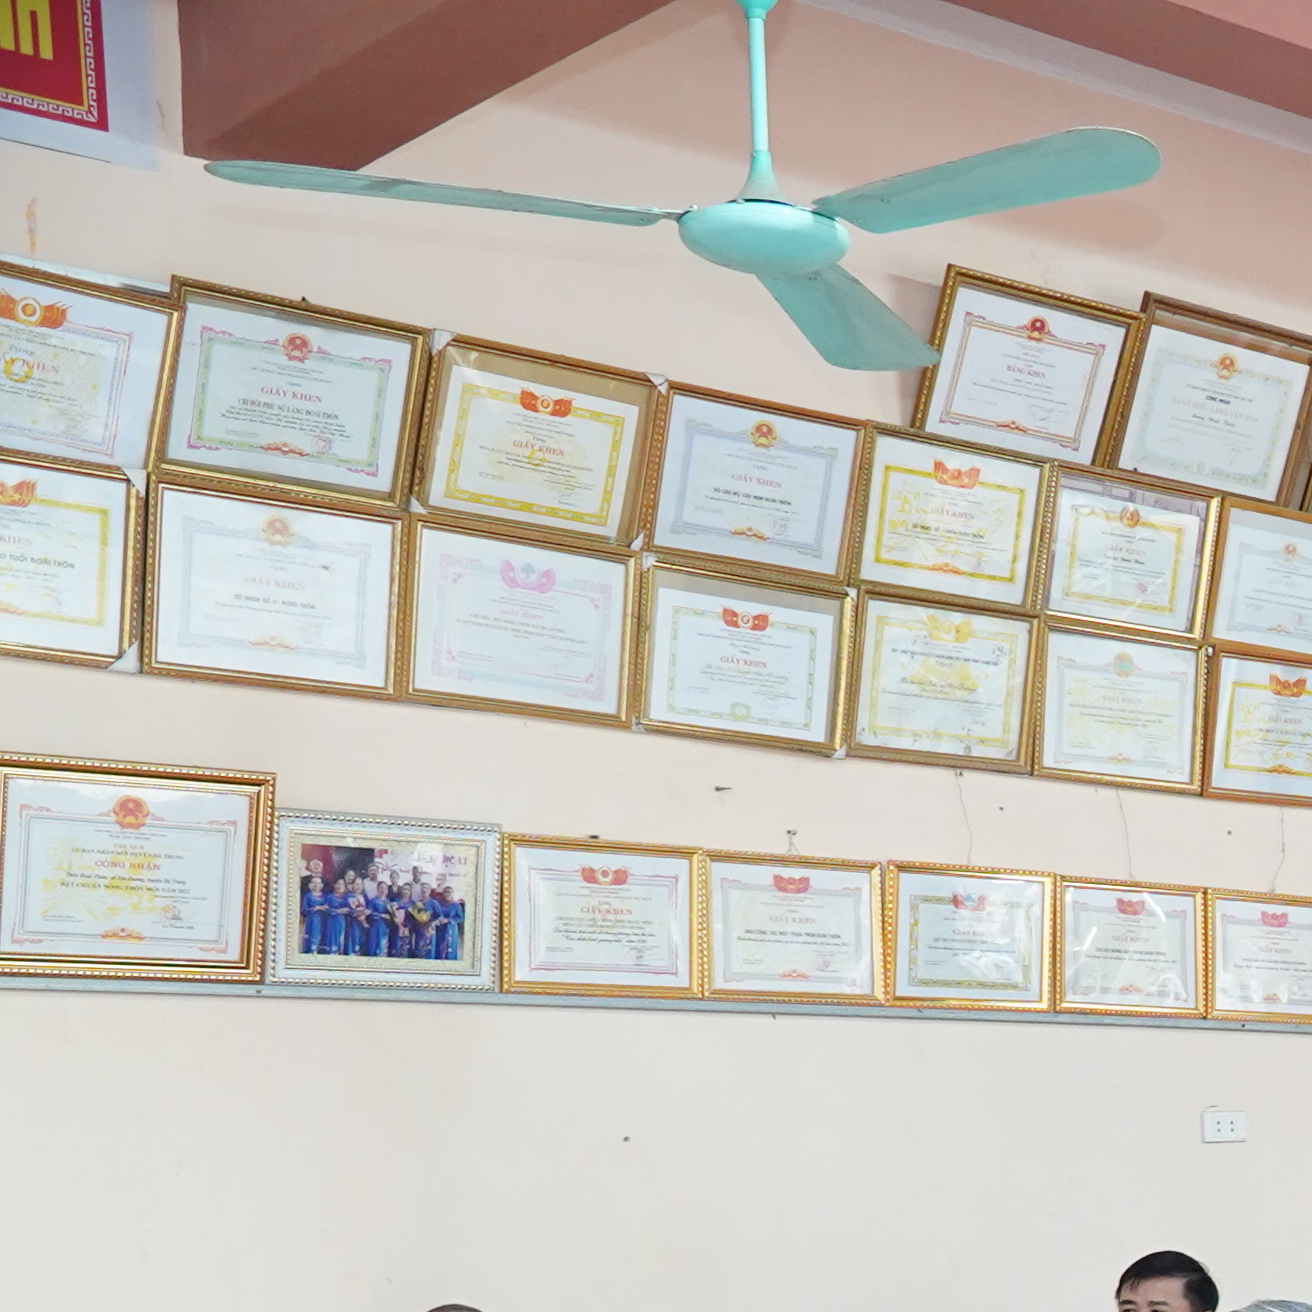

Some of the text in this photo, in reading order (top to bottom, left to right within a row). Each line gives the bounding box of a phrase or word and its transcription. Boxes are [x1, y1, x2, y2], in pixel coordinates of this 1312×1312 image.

[261, 385, 323, 404] GIẤY KHEN
[513, 440, 565, 457] GIẤY KHEN
[720, 654, 768, 670] GIẤY KHEN
[94, 858, 162, 872] CÔNG NHẬN
[580, 906, 633, 917] GIẤY KHEN
[769, 914, 818, 925] GIẤY KHEN
